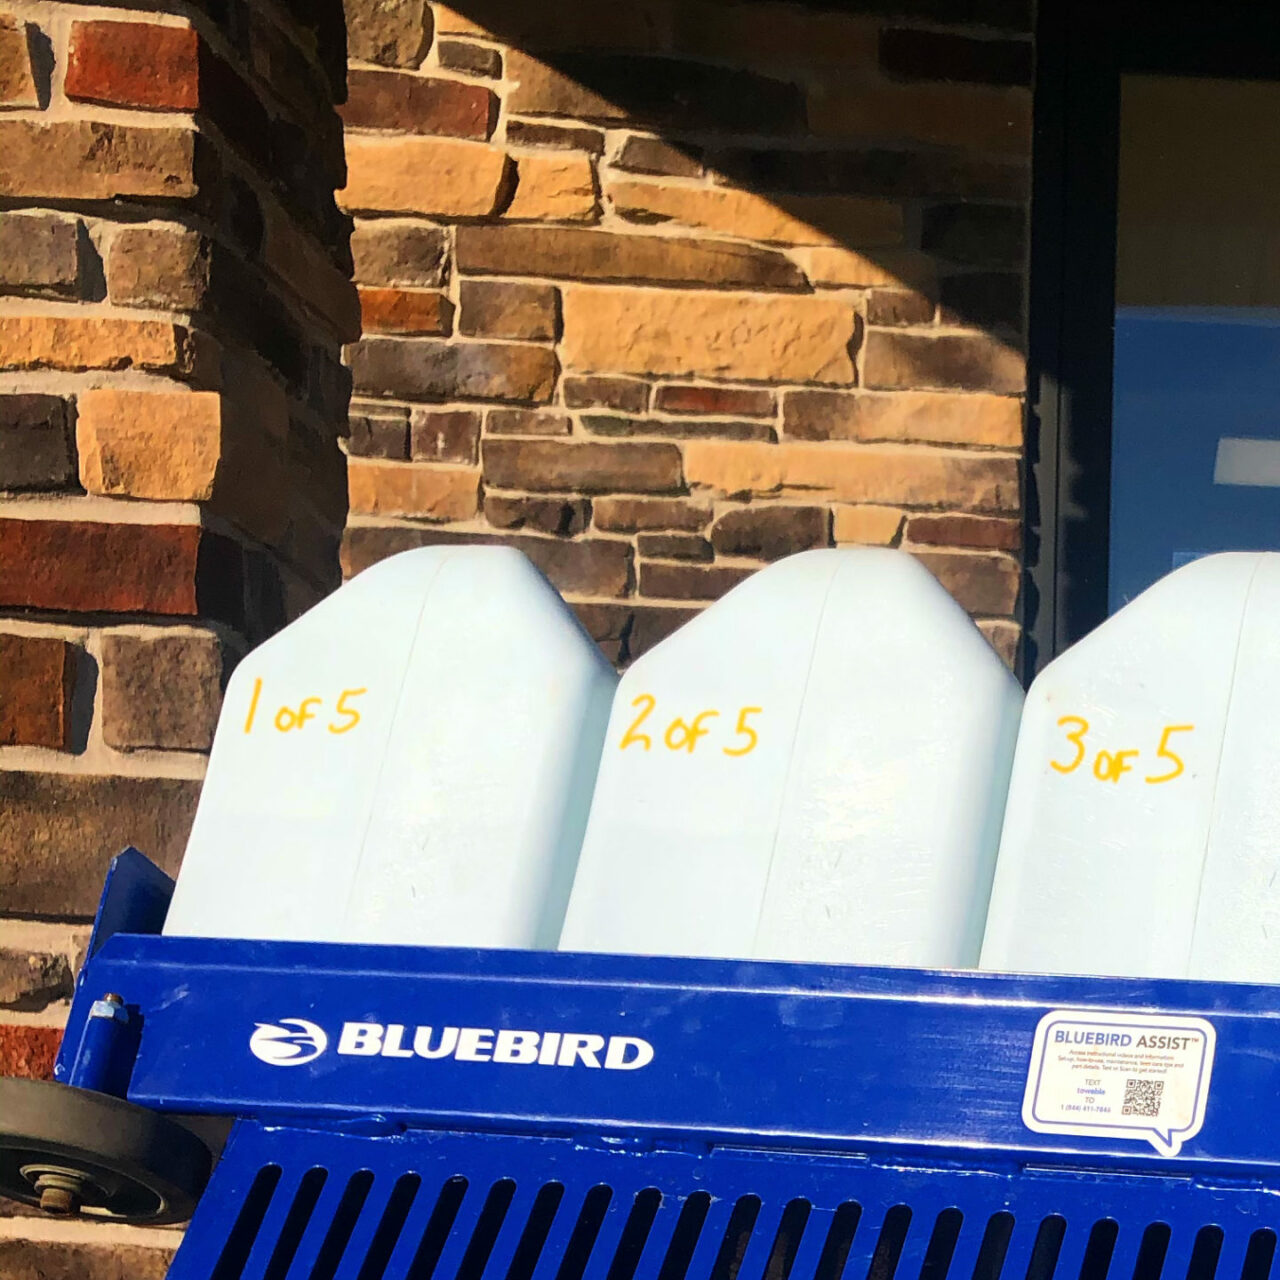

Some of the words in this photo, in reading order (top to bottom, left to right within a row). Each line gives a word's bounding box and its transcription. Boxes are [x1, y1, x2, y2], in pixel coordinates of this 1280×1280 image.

[244, 677, 263, 734] 1
[327, 686, 368, 735] 5
[619, 693, 656, 750] 2
[722, 706, 763, 757] 5
[1049, 714, 1090, 775] 3
[1144, 724, 1195, 785] 5
[337, 1021, 655, 1071] BLUEBIRD
[1054, 1030, 1132, 1047] BLUEBIRD
[1077, 1087, 1106, 1096] towable
[1085, 1078, 1102, 1086] TEXT
[1085, 1096, 1095, 1104] TO
